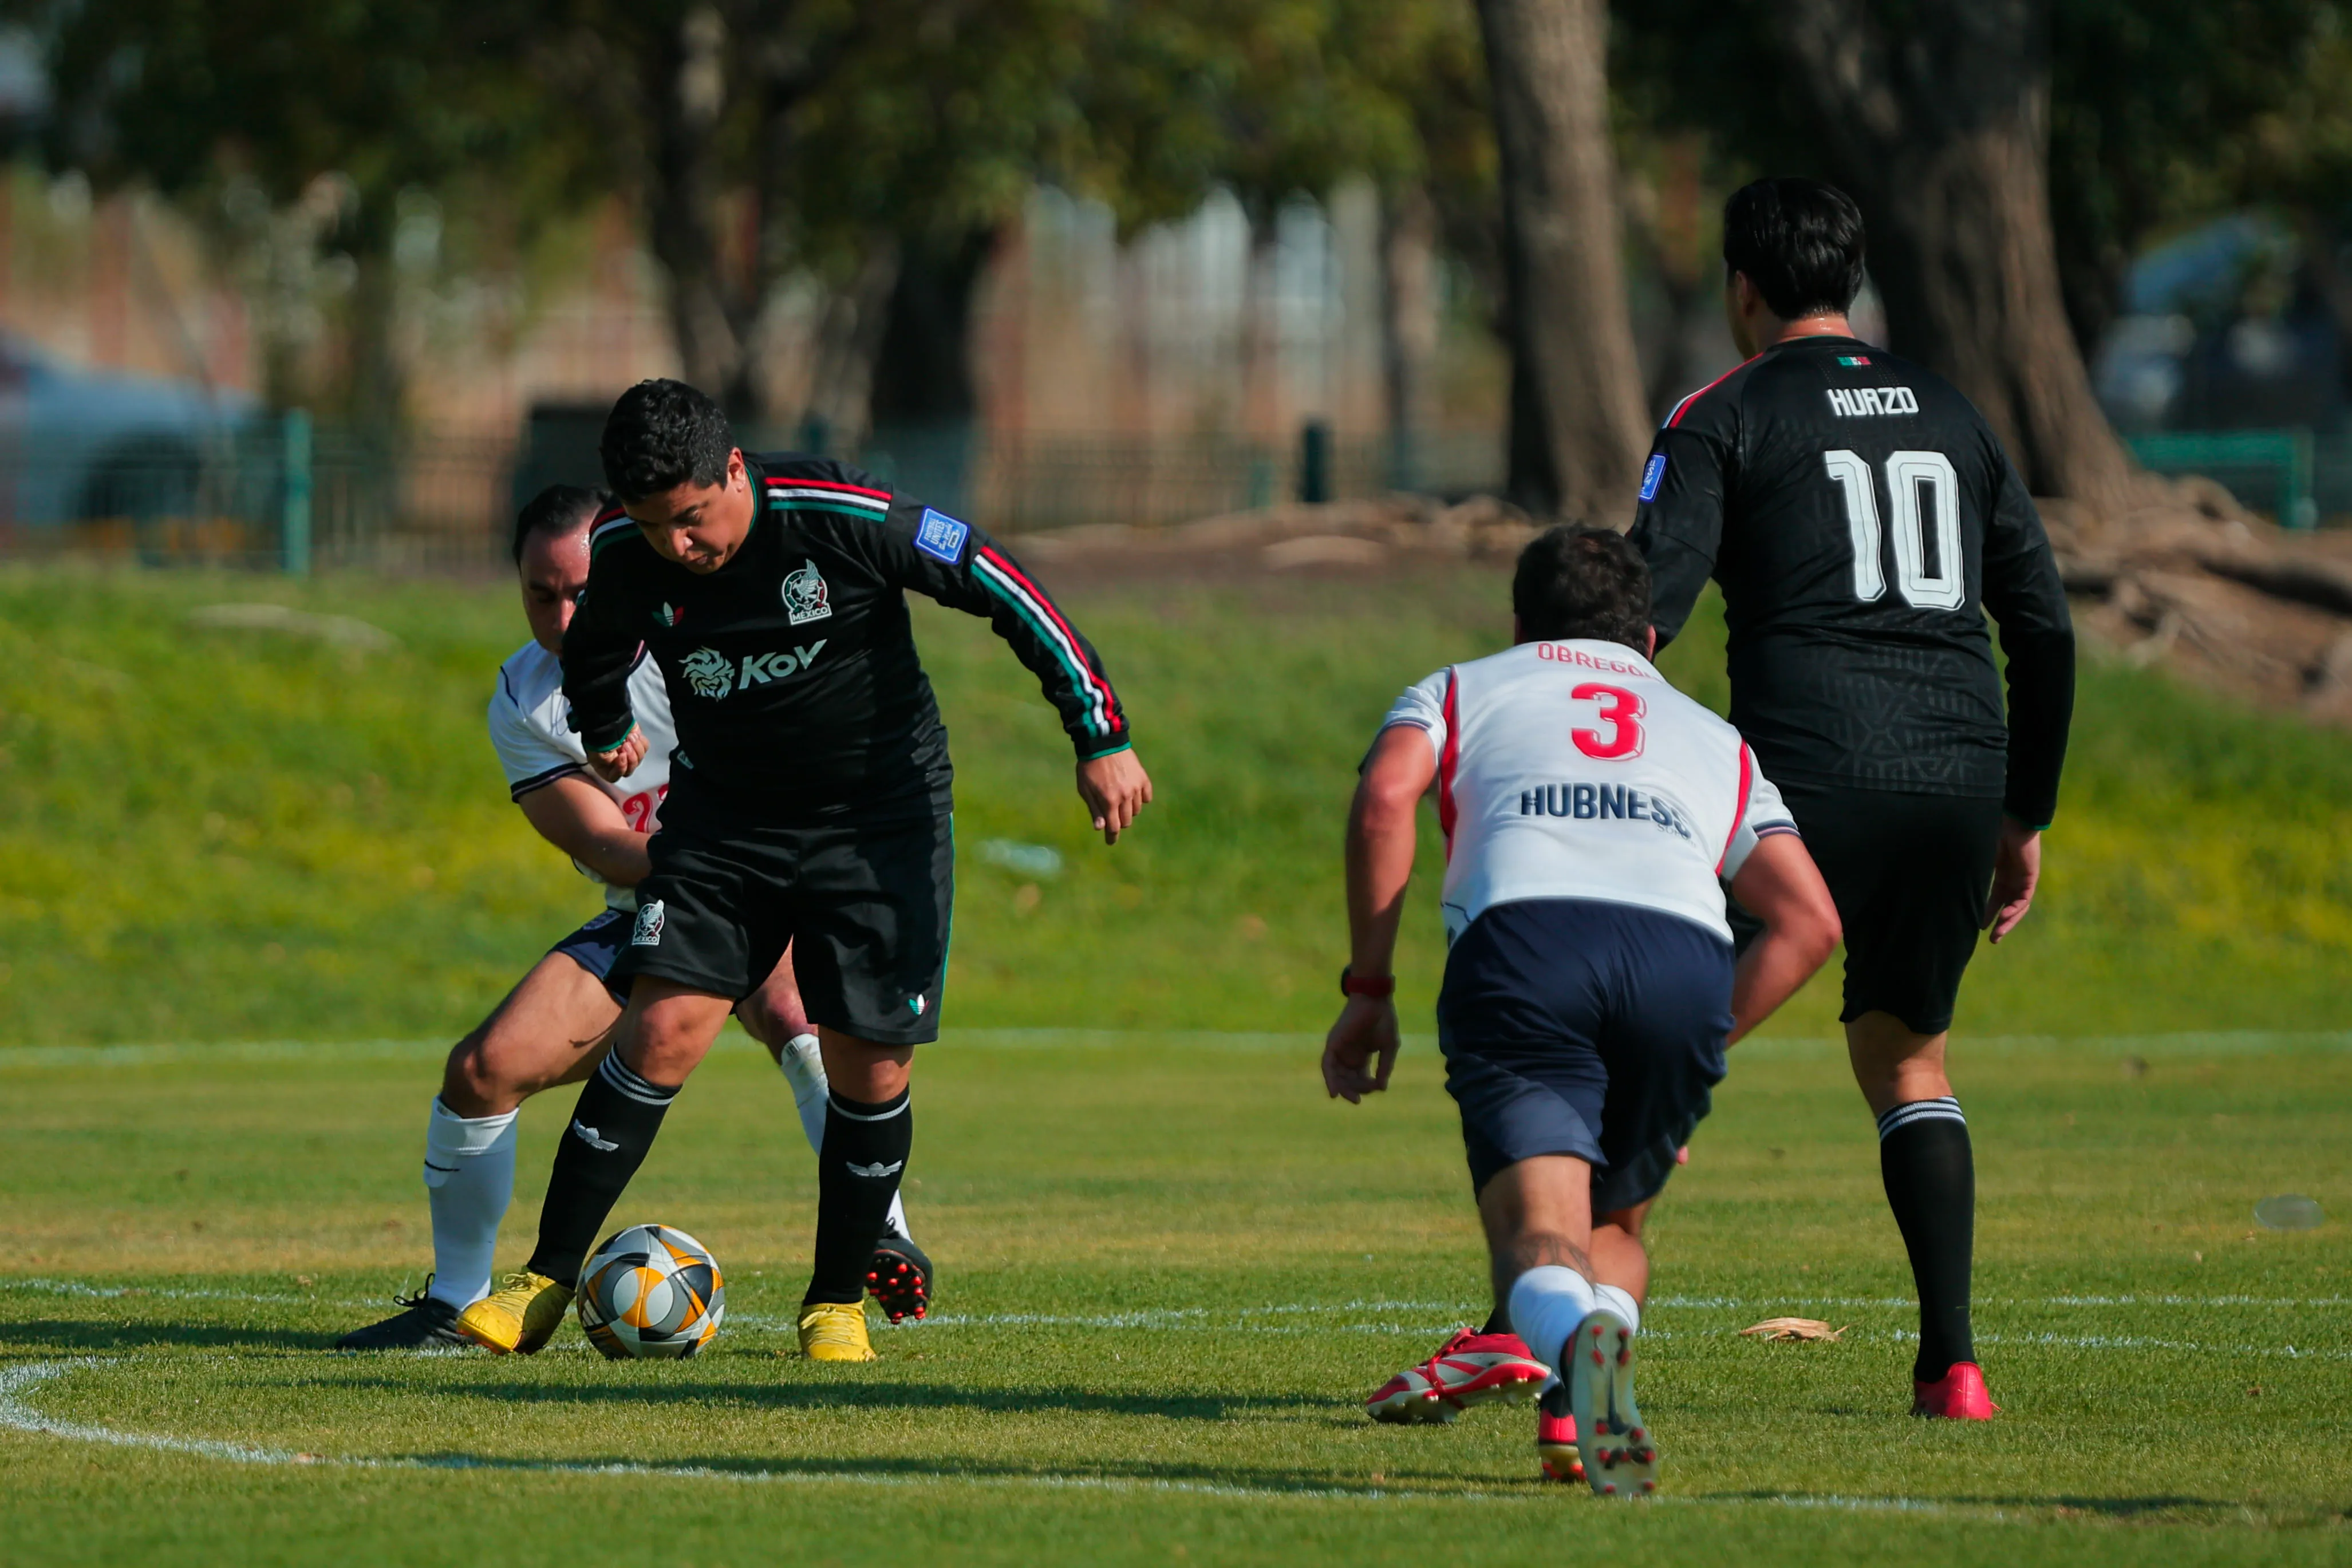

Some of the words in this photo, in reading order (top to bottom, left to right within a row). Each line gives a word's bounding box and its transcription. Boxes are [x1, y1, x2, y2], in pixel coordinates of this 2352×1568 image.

[1827, 387, 1919, 416] HUAZO
[929, 519, 945, 545] UNITES
[1824, 449, 1966, 611] 10
[792, 607, 828, 621] MÉXICO
[1538, 642, 1664, 682] OBREGO
[1571, 682, 1647, 762] 3
[623, 783, 669, 834] 2
